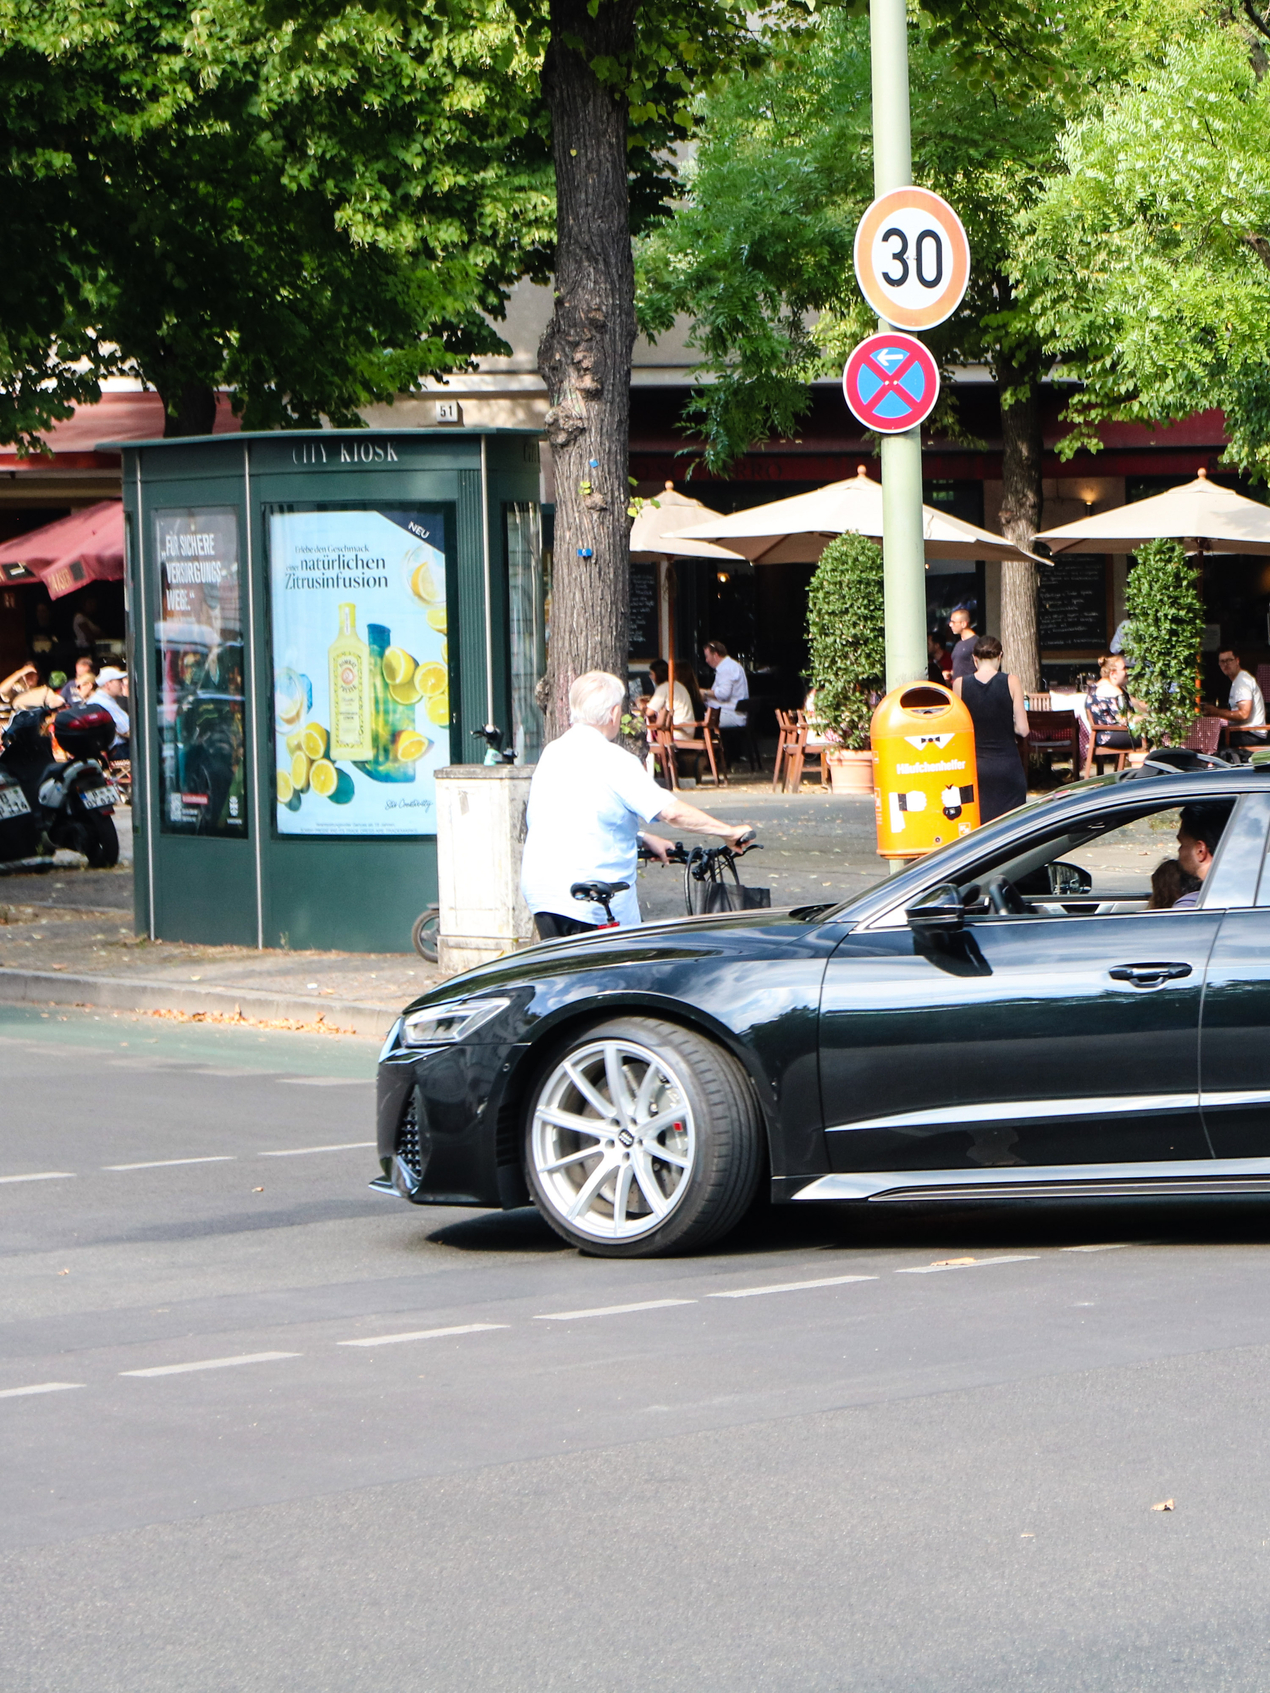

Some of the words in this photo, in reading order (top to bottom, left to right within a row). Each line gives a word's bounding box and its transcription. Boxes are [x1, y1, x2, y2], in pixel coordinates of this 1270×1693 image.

[881, 227, 943, 289] 30
[439, 405, 454, 418] 51
[340, 441, 399, 463] KIOSK
[408, 521, 429, 540] NEU
[180, 533, 216, 557] SICHERE
[327, 545, 370, 553] Geschmack
[299, 553, 387, 572] natürlichen
[285, 572, 389, 590] Zitrusinfusion
[896, 758, 966, 775] Häufchenhelfer
